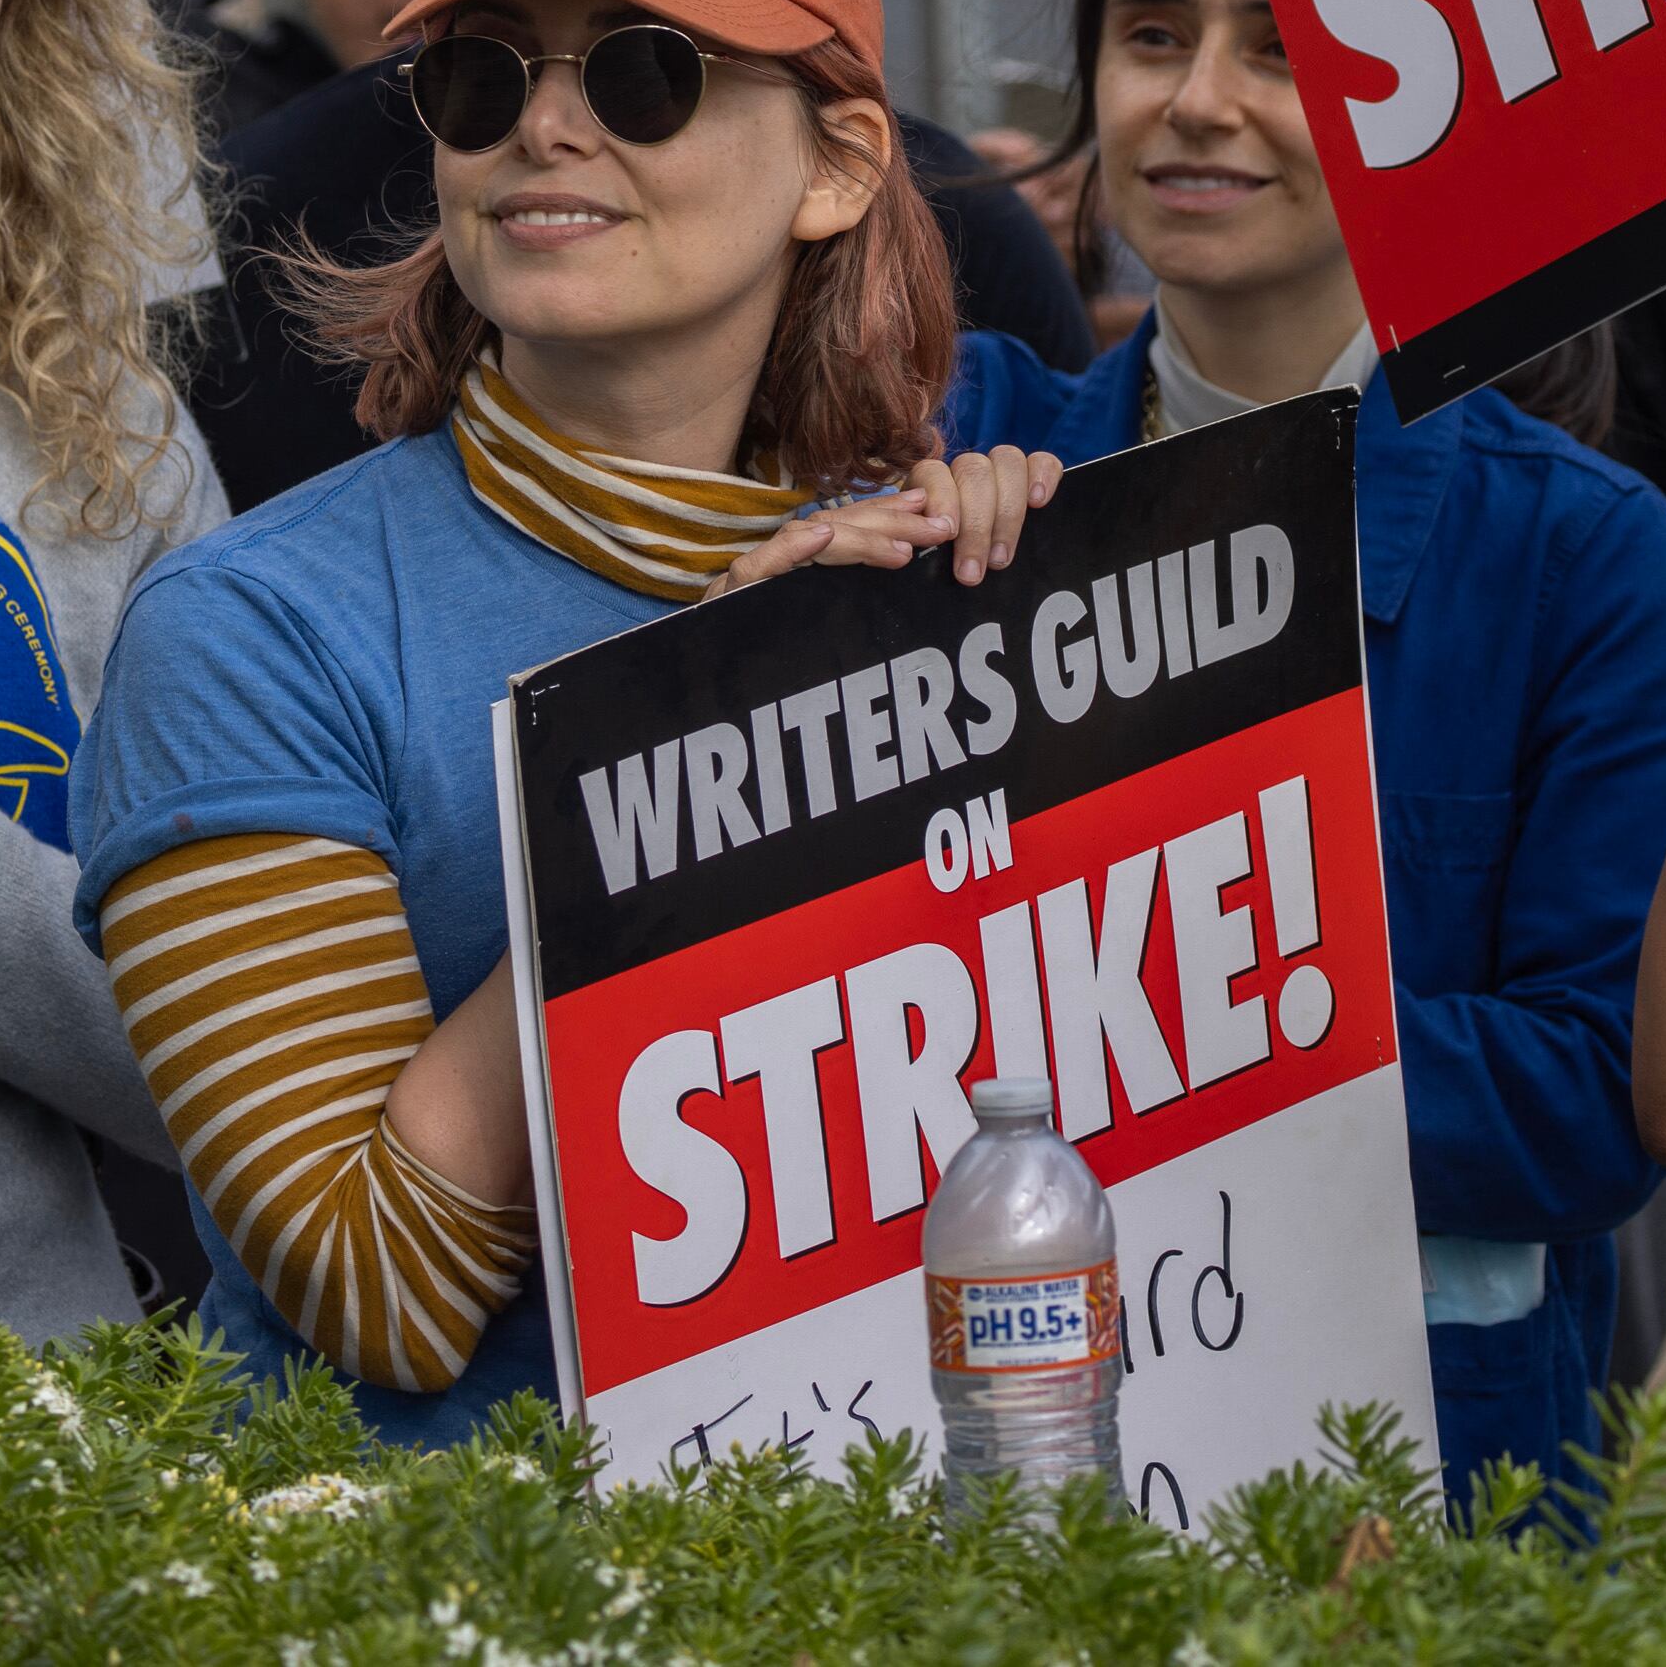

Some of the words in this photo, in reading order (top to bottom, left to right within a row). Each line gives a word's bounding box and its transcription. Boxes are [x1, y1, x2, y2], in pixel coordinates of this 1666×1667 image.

[5, 600, 59, 706] CEREMONY
[577, 621, 1019, 897] WRITERS
[1030, 523, 1297, 724] GUILD
[924, 789, 1014, 895] ON
[616, 774, 1335, 1308] STRIKE!
[969, 1308, 1013, 1348] pH
[1020, 1305, 1082, 1341] 9.5+
[985, 1283, 1039, 1297] ALKALINE
[1044, 1279, 1079, 1293] WATER
